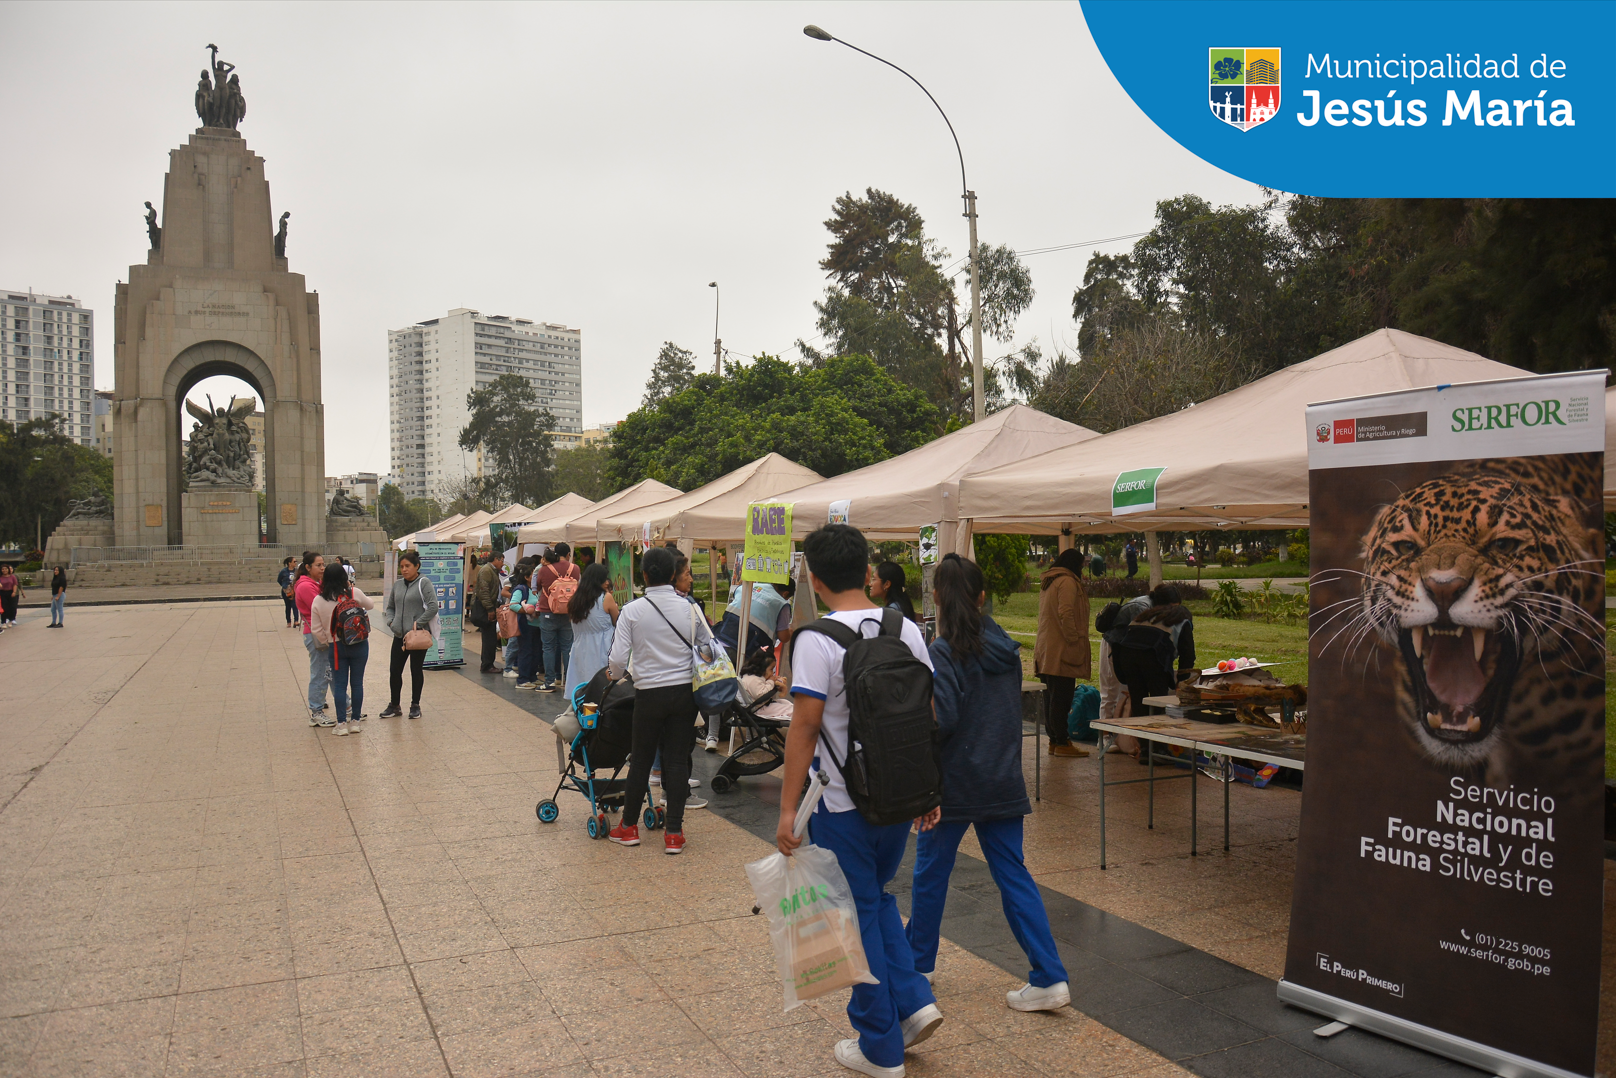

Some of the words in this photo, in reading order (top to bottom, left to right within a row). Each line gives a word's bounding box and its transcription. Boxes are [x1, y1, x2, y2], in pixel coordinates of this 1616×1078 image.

[1335, 426, 1353, 436] PERÚ
[1357, 425, 1386, 433] Ministerio
[1451, 399, 1567, 432] SERFOR
[1366, 430, 1396, 438] Agricultura
[1115, 479, 1146, 493] SERFOR
[751, 506, 786, 536] RAEE
[1449, 776, 1555, 813] Servicio
[1436, 800, 1555, 841] Nacional
[1387, 816, 1491, 858] Forestal
[1498, 843, 1513, 867] y
[1521, 843, 1554, 869] de
[1360, 836, 1431, 872] Fauna
[1439, 853, 1553, 896] Silvestre
[1439, 940, 1551, 976] www.serfor.gob.pe
[1475, 932, 1496, 948] (01)
[1498, 938, 1519, 952] 225
[1521, 944, 1551, 960] 9005
